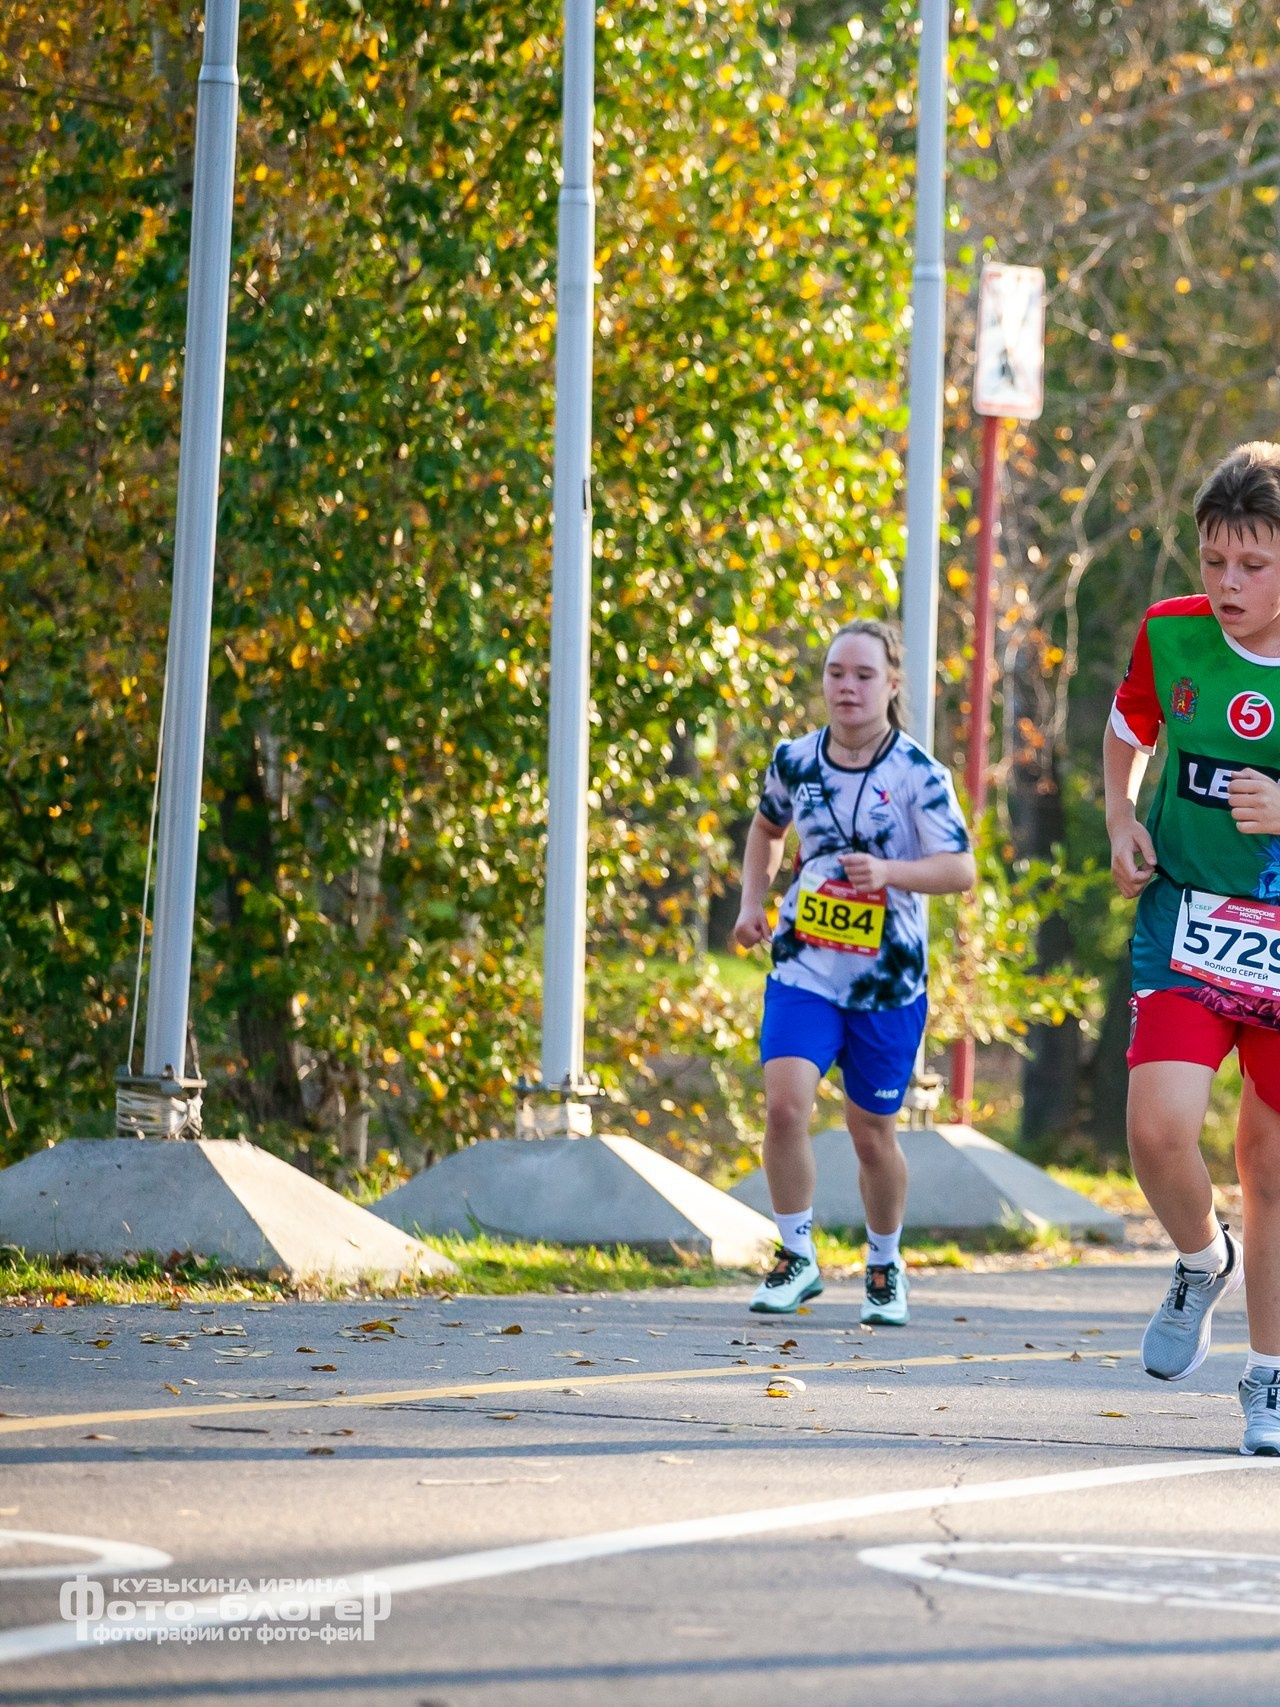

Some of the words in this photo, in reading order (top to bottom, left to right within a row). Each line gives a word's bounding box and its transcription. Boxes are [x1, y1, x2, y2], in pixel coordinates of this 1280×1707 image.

[802, 895, 874, 935] 5184
[1227, 904, 1276, 919] КРАСНОЯРСКИЕ
[1239, 911, 1262, 921] МОСТЫ
[1204, 960, 1238, 974] ВОЛКОВ
[1238, 968, 1269, 981] СЕРГЕЙ
